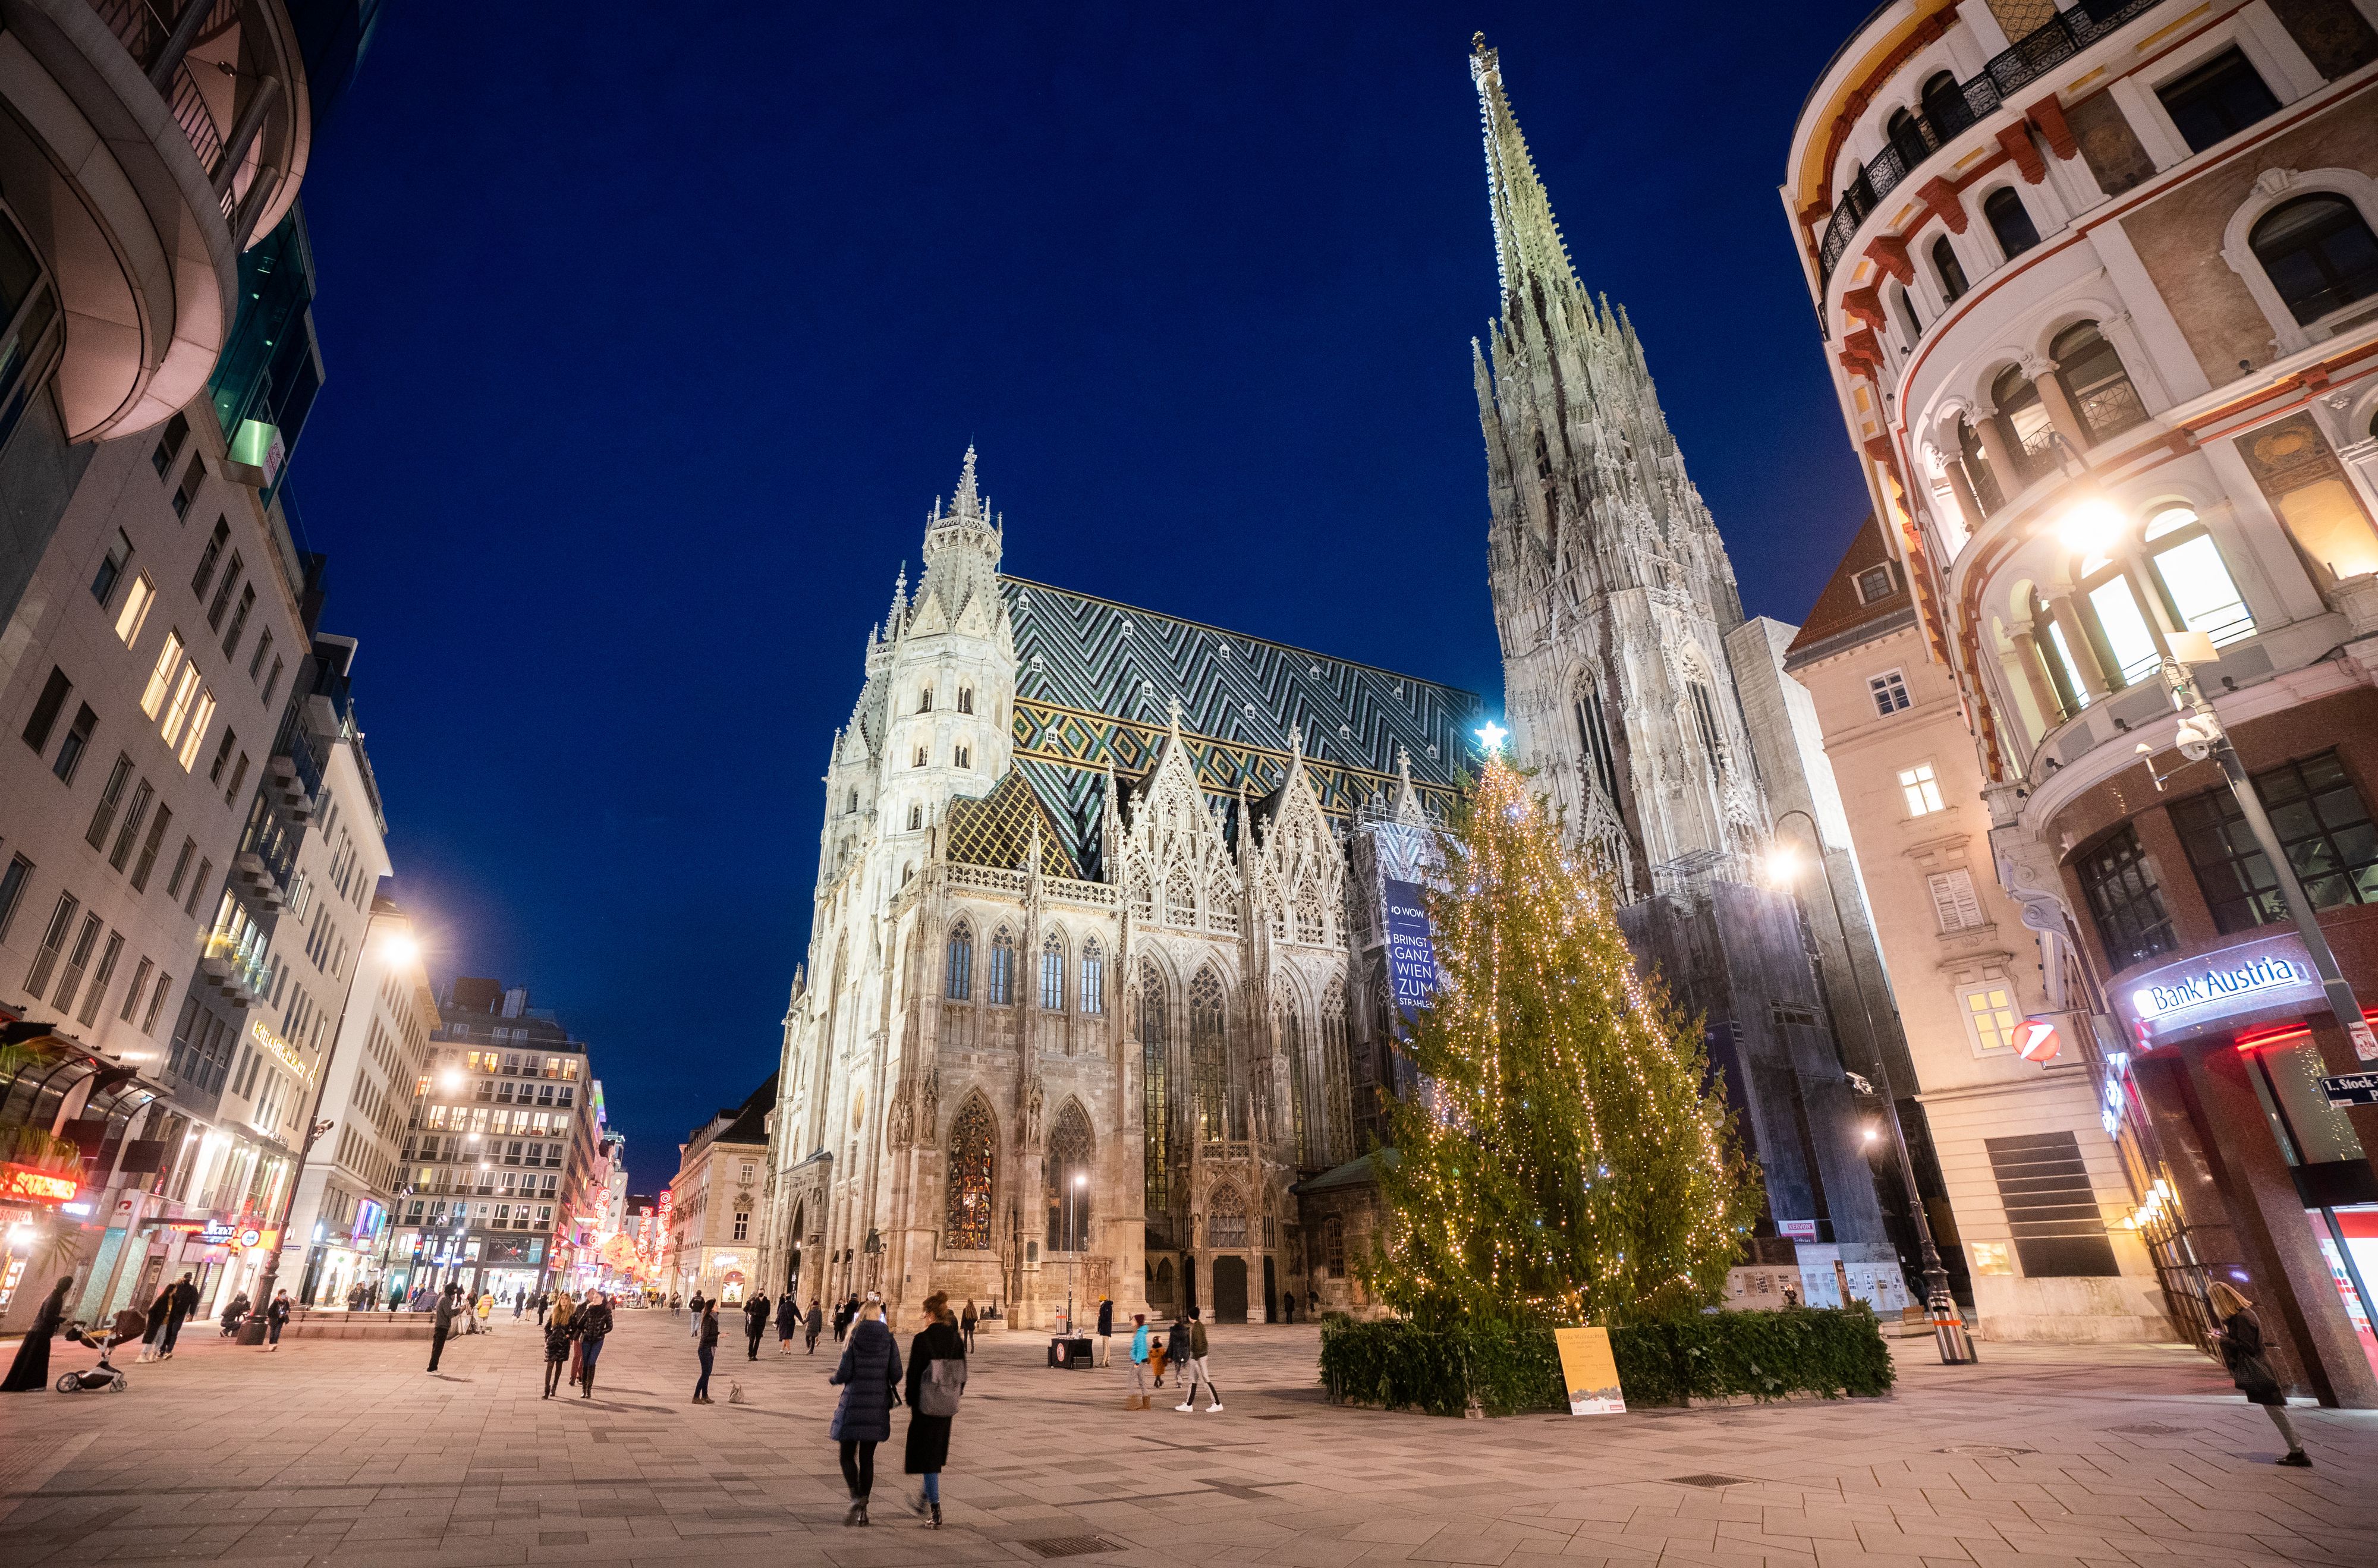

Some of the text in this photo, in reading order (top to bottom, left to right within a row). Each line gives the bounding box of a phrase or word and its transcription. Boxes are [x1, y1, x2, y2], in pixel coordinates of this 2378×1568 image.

[1402, 907, 1424, 918] WOW
[1393, 934, 1427, 947] BRINGT
[1395, 946, 1430, 962] GANZ
[1396, 961, 1432, 978] WIEN
[1398, 978, 1433, 997] ZUM
[2151, 956, 2294, 1010] Bank Austria
[169, 1224, 205, 1232] ruefa
